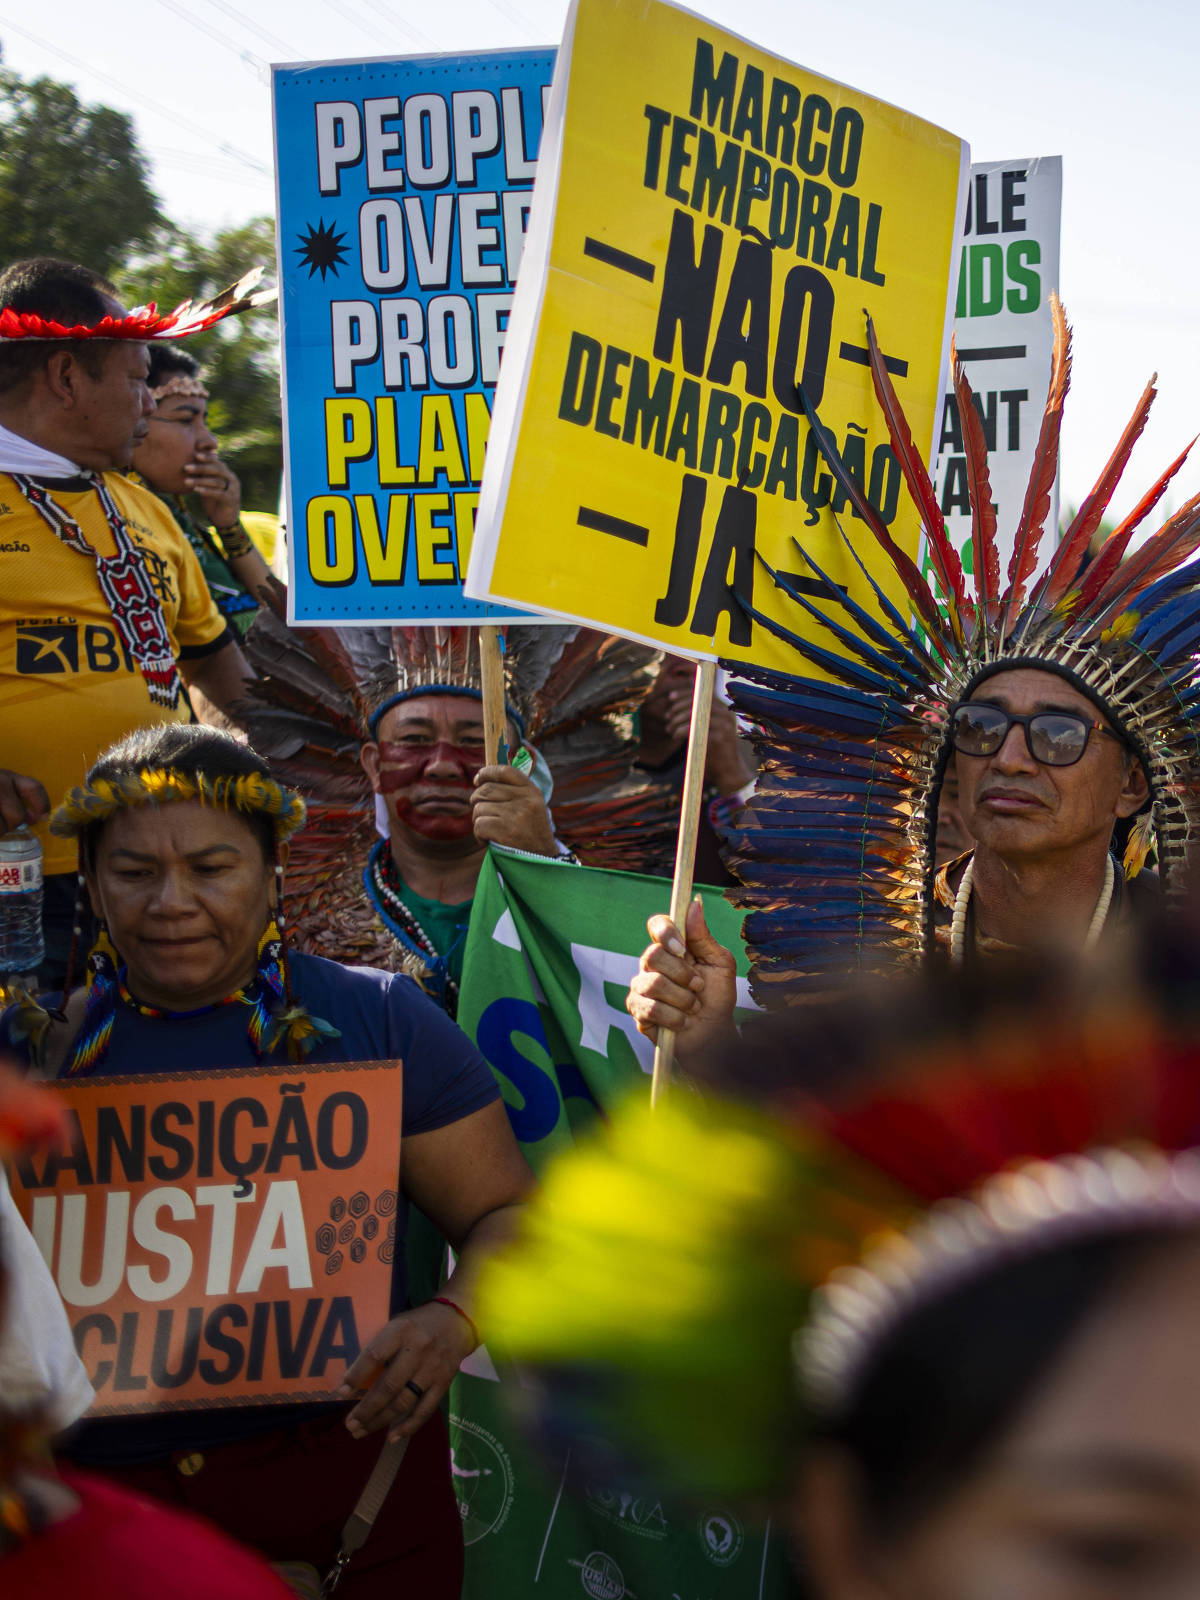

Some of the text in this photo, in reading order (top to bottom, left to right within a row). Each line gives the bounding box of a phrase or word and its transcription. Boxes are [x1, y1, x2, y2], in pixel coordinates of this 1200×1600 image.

[314, 84, 552, 197] PEOPL
[644, 103, 886, 287] TEMPORAL
[689, 37, 865, 188] MARCO
[963, 170, 1027, 237] LE
[653, 207, 835, 415] NÃO
[558, 331, 902, 526] DEMARCAÇÃO
[654, 466, 757, 647] JÁ
